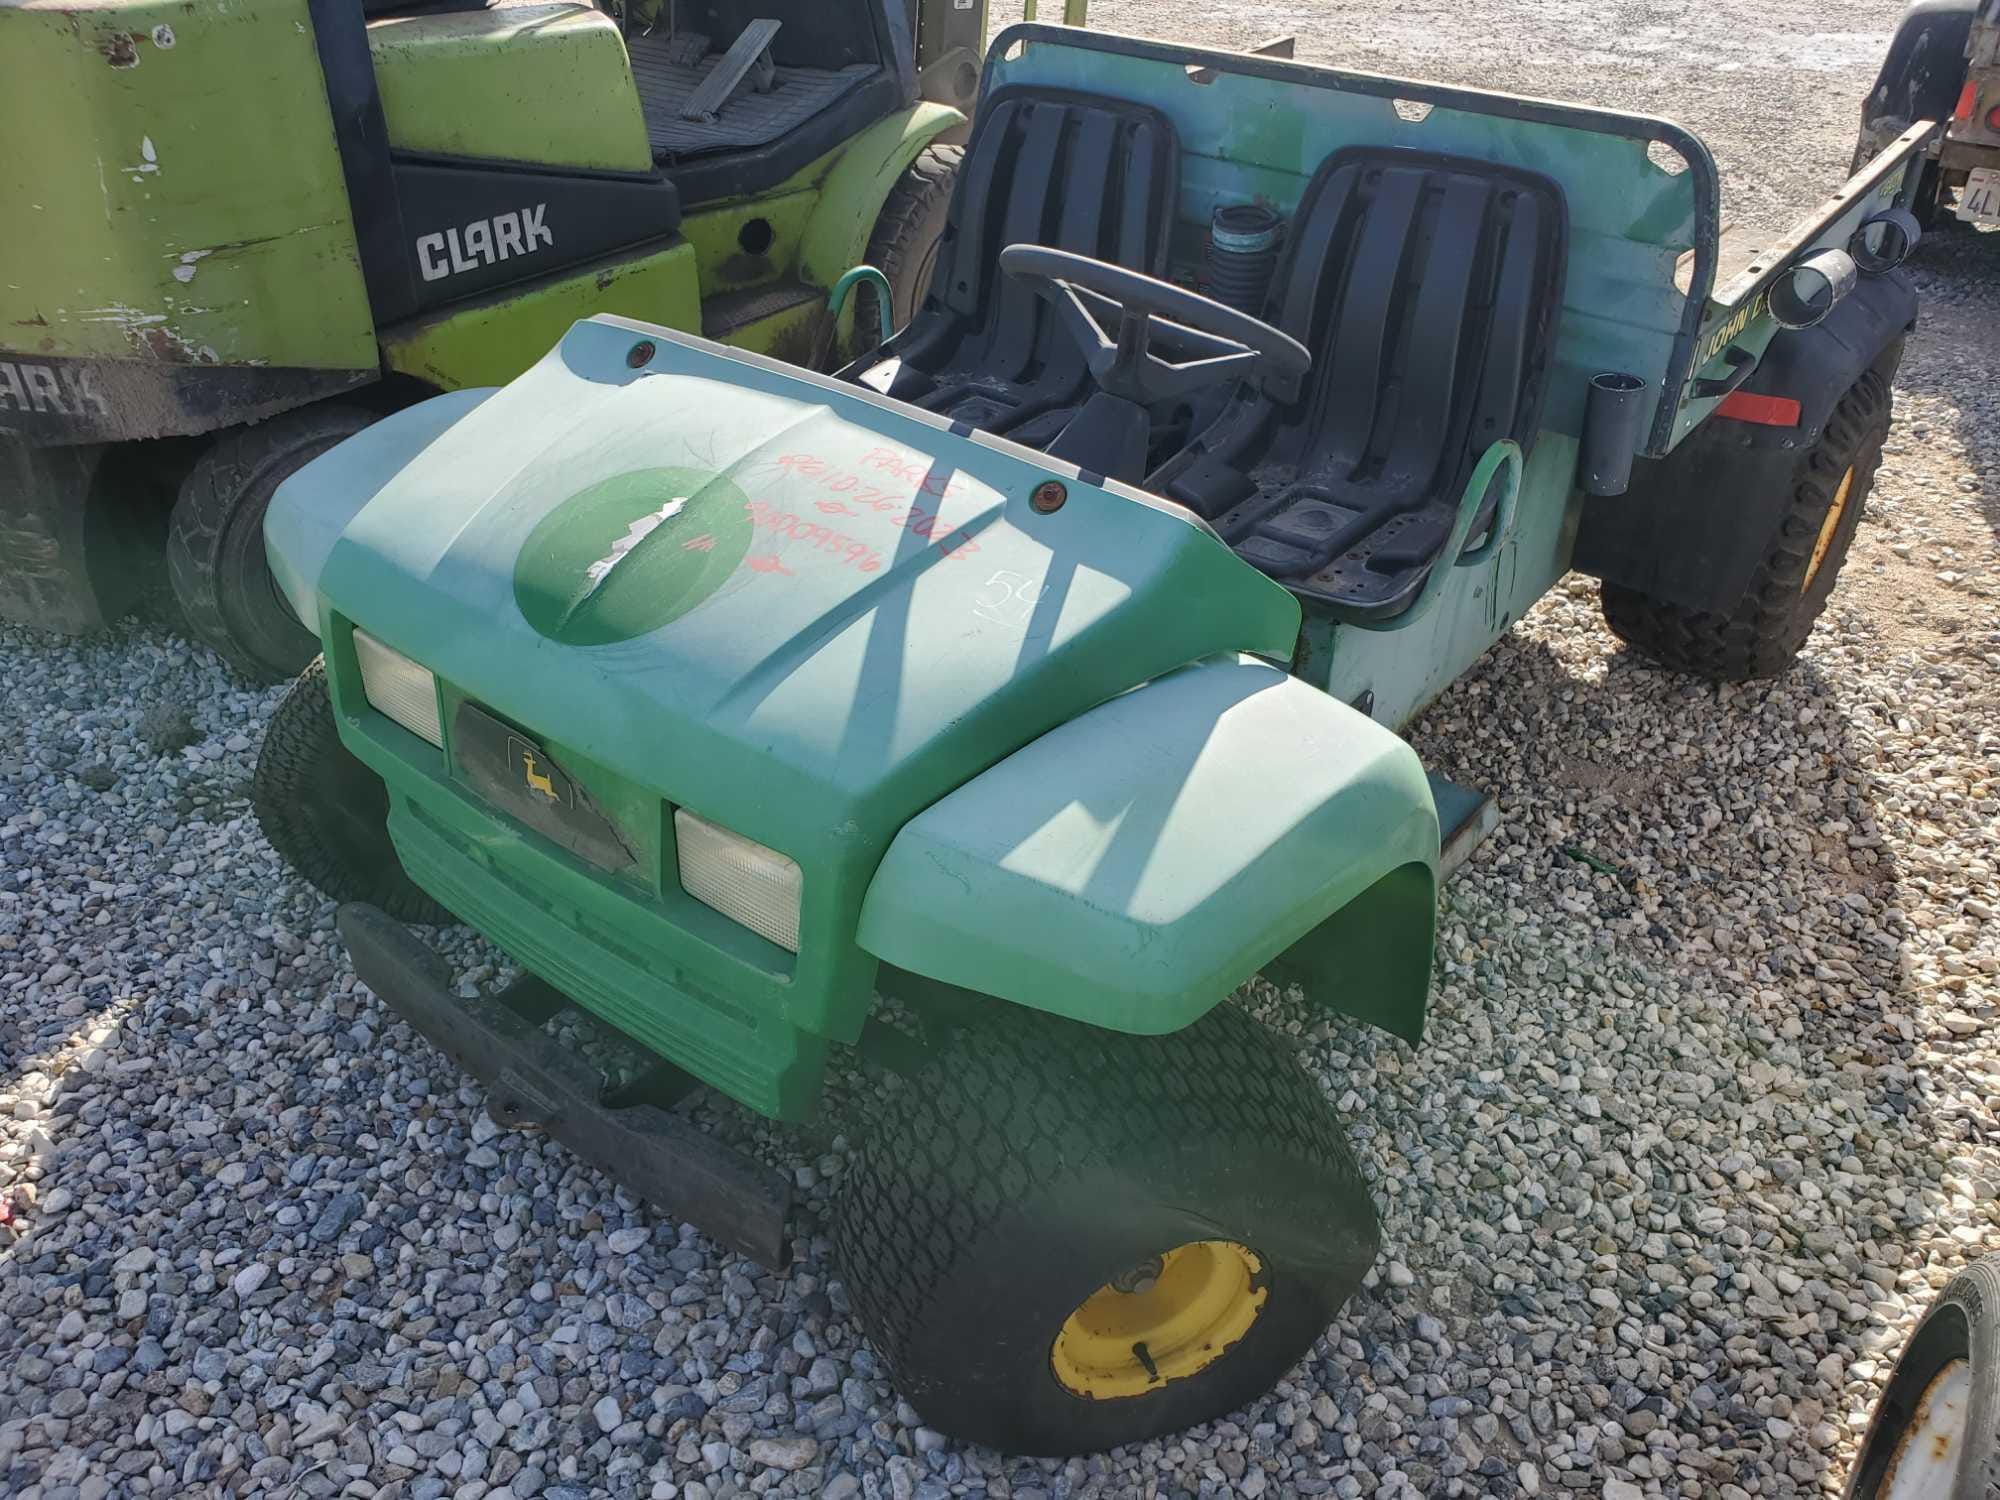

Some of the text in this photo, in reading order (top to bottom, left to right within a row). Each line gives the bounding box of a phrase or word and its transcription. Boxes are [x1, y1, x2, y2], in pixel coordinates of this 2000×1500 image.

[1967, 188, 2000, 217] 4L
[416, 203, 553, 282] CLARK
[1702, 303, 1750, 365] JOHN
